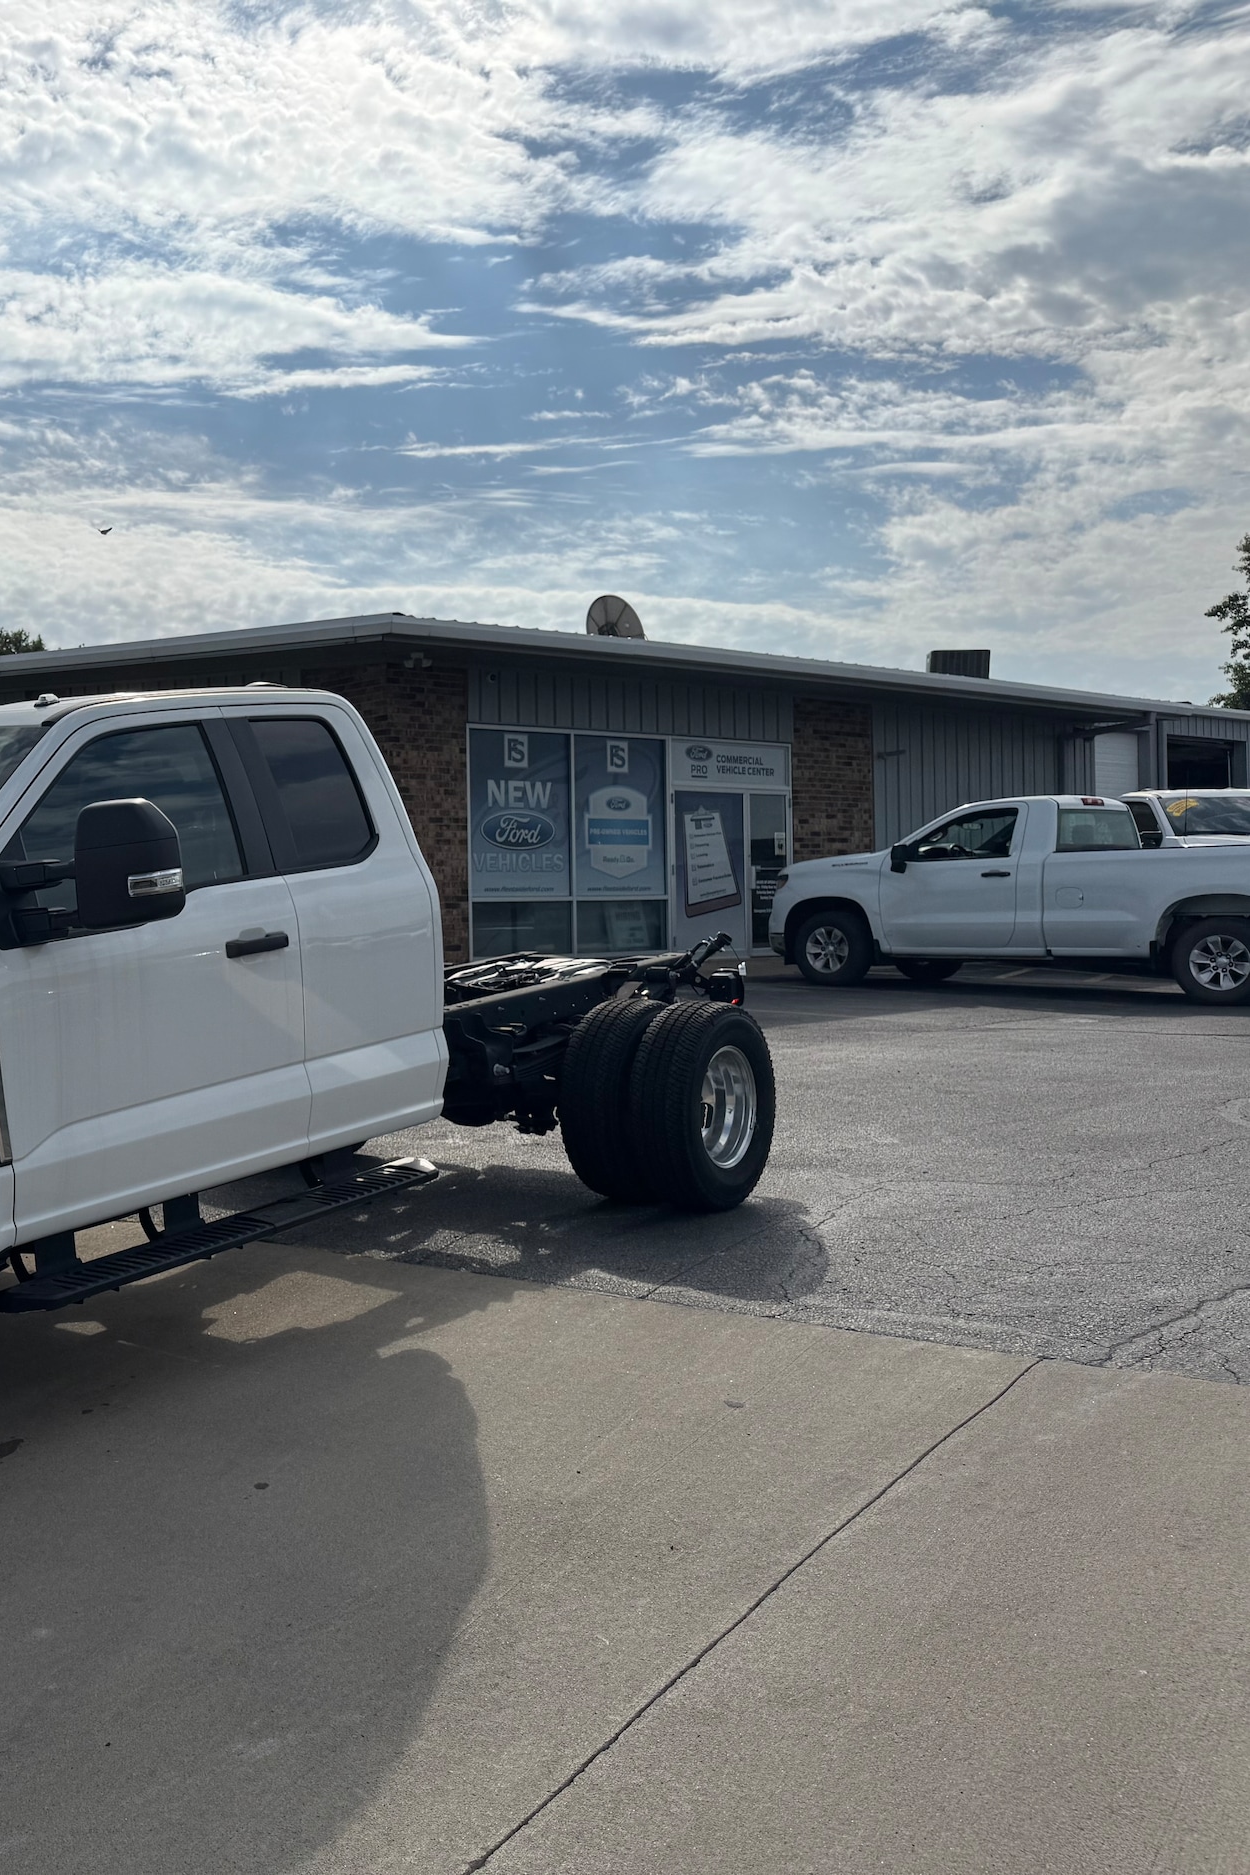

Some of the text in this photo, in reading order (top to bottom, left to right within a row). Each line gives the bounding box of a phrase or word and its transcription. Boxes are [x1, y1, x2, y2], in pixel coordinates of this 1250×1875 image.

[716, 754, 764, 766] COMMERCIAL
[690, 764, 708, 775] PRO
[716, 765, 775, 777] VEHICLE CENTER
[487, 779, 552, 809] NEW
[495, 814, 542, 844] Ford
[472, 852, 565, 873] VEHICLES
